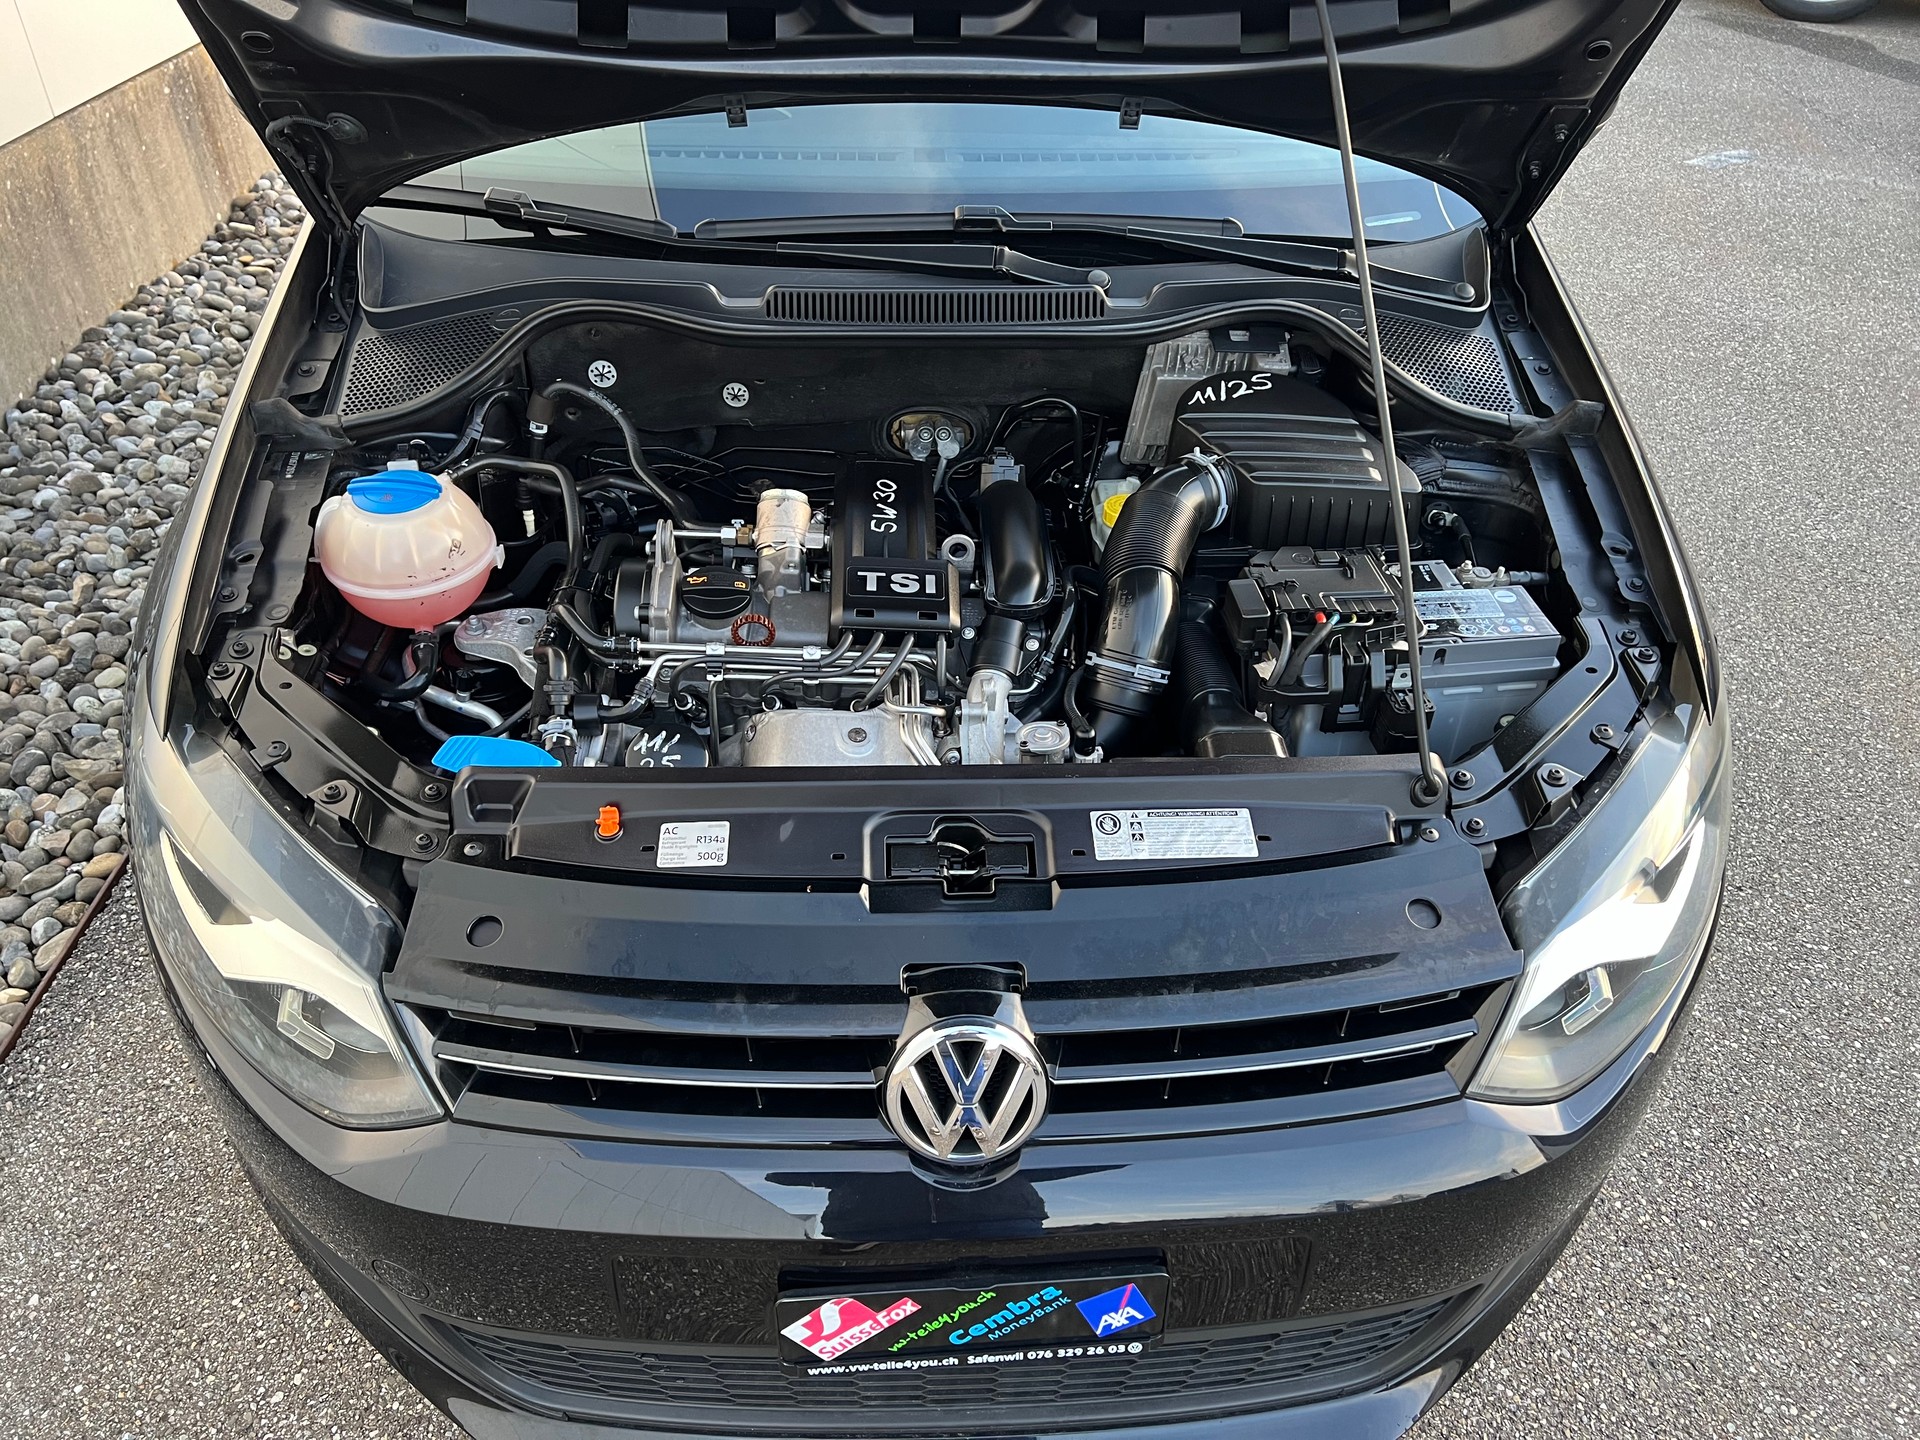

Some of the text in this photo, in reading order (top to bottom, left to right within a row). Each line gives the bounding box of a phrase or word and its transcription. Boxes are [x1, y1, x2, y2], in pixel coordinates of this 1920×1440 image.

[1187, 372, 1273, 405] 11/25
[857, 571, 936, 594] TSI
[663, 826, 679, 835] AC
[696, 835, 726, 844] R134a
[697, 851, 725, 863] 500g
[948, 1286, 1063, 1345] Cembra
[987, 1296, 1072, 1341] MoneyBank
[1095, 1306, 1145, 1335] AXA
[818, 1300, 919, 1359] SuisseFox
[1027, 1350, 1053, 1360] 076
[1057, 1347, 1083, 1358] 329
[1086, 1345, 1105, 1355] 26
[1108, 1344, 1126, 1354] 03
